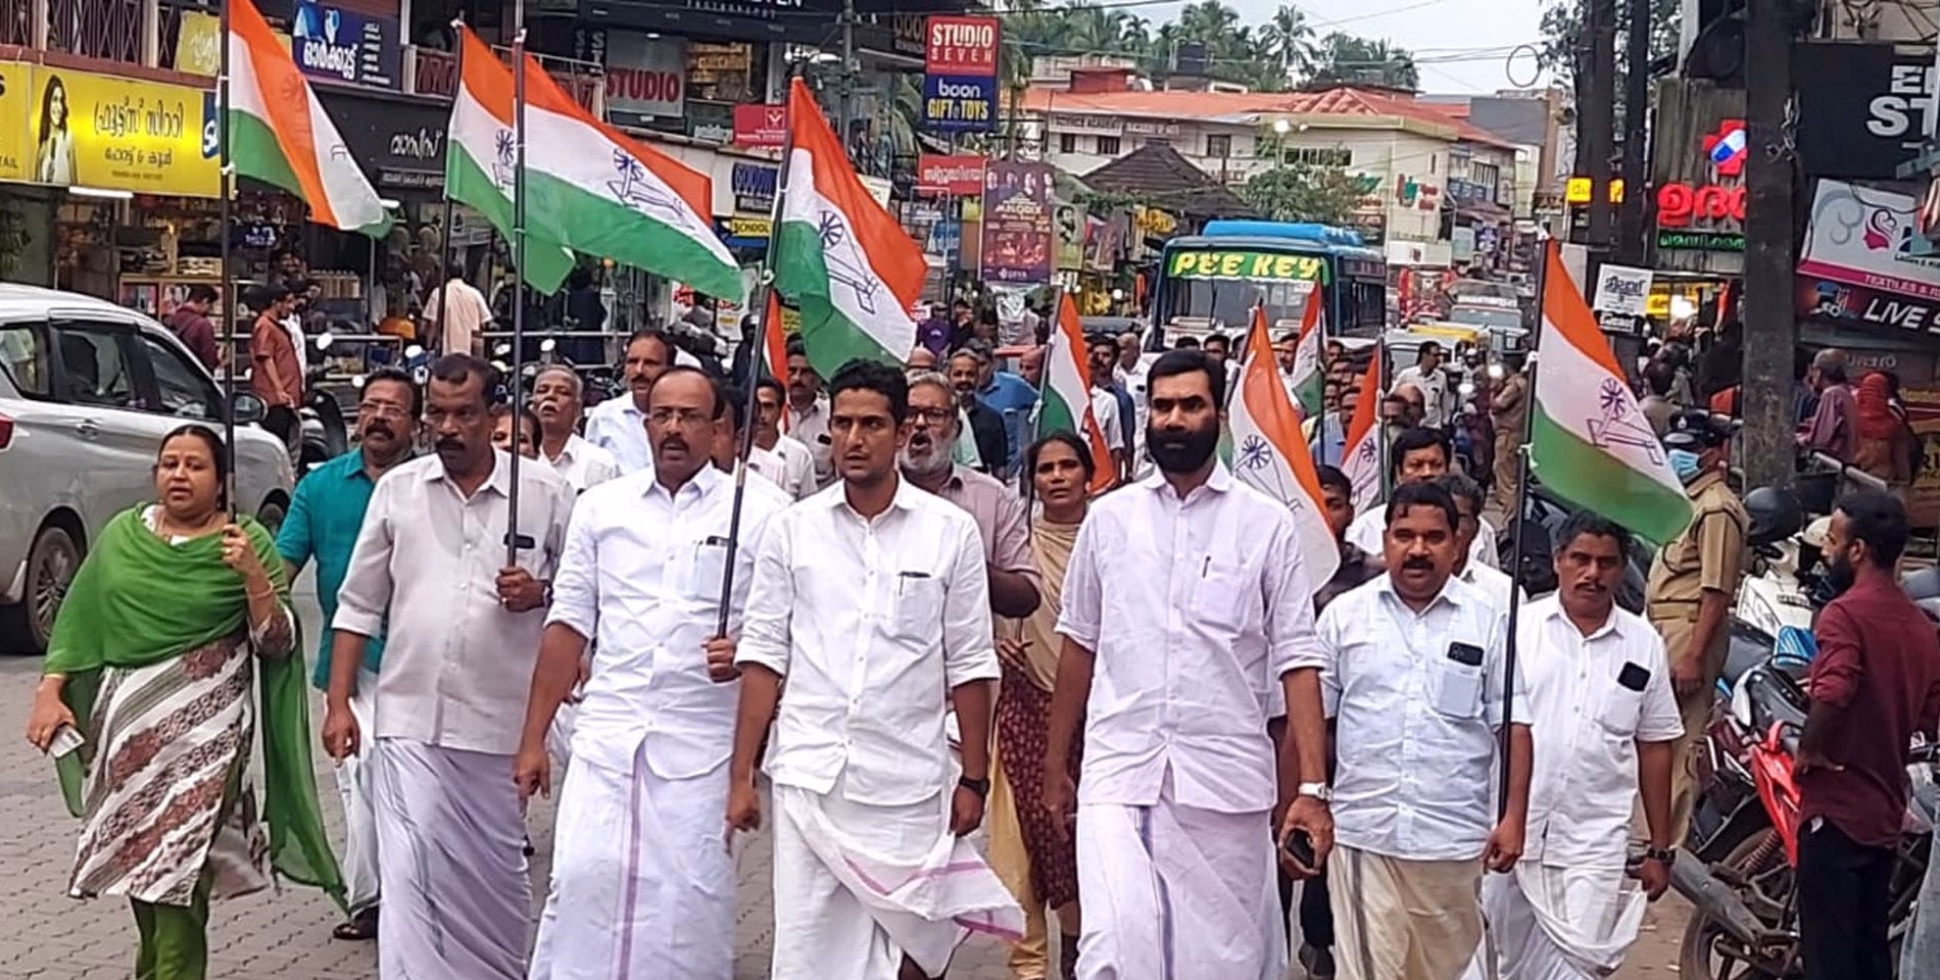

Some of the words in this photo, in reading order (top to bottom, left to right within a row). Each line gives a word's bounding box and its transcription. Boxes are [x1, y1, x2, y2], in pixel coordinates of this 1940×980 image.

[932, 22, 993, 48] STUDIO
[931, 47, 992, 63] SEVEN
[606, 67, 680, 102] STUDIO
[938, 77, 981, 98] boon
[927, 98, 953, 118] GIFT
[961, 100, 989, 120] TOYS
[734, 222, 770, 235] SCHOOL
[1174, 252, 1244, 275] PEE
[1252, 254, 1320, 279] KEY
[1863, 298, 1928, 329] LIVE
